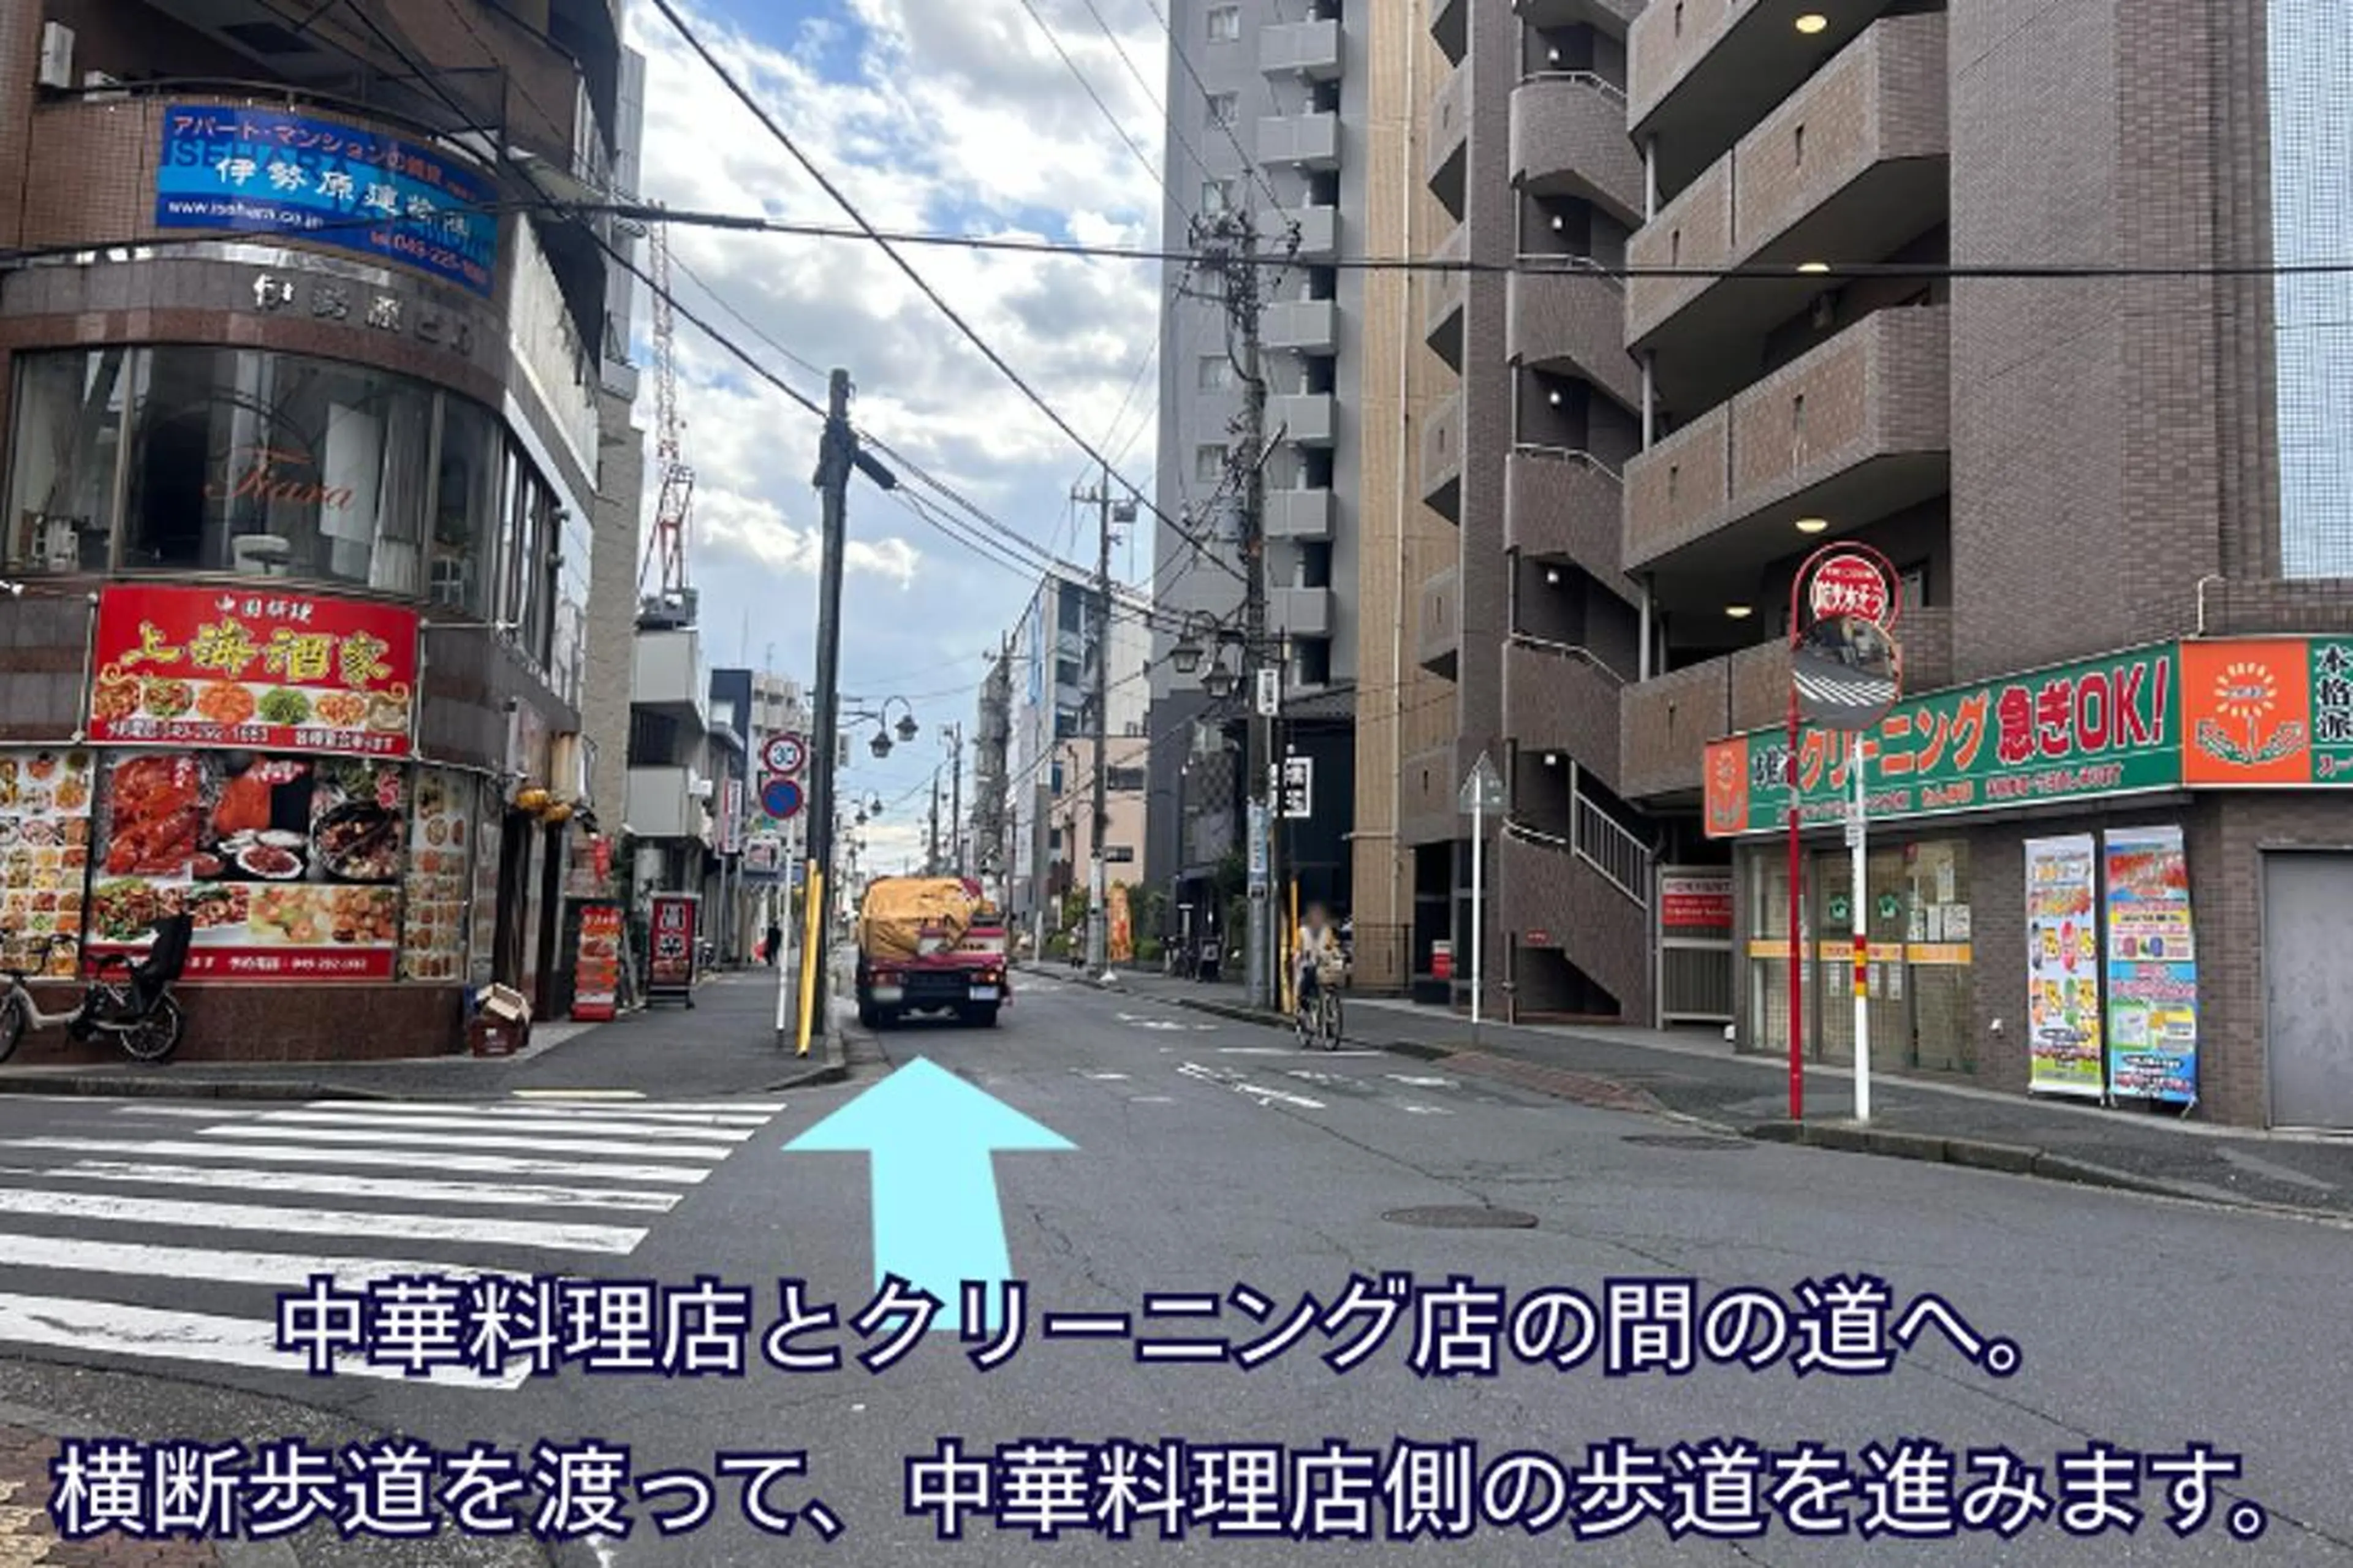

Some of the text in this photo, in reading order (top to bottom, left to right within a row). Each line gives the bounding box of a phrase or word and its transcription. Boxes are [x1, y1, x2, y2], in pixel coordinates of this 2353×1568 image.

[120, 616, 393, 694] 上海酒家
[2316, 644, 2353, 742] 本格派
[1800, 692, 1990, 793] クリーニング
[1996, 654, 2170, 764] 急ぎOK!
